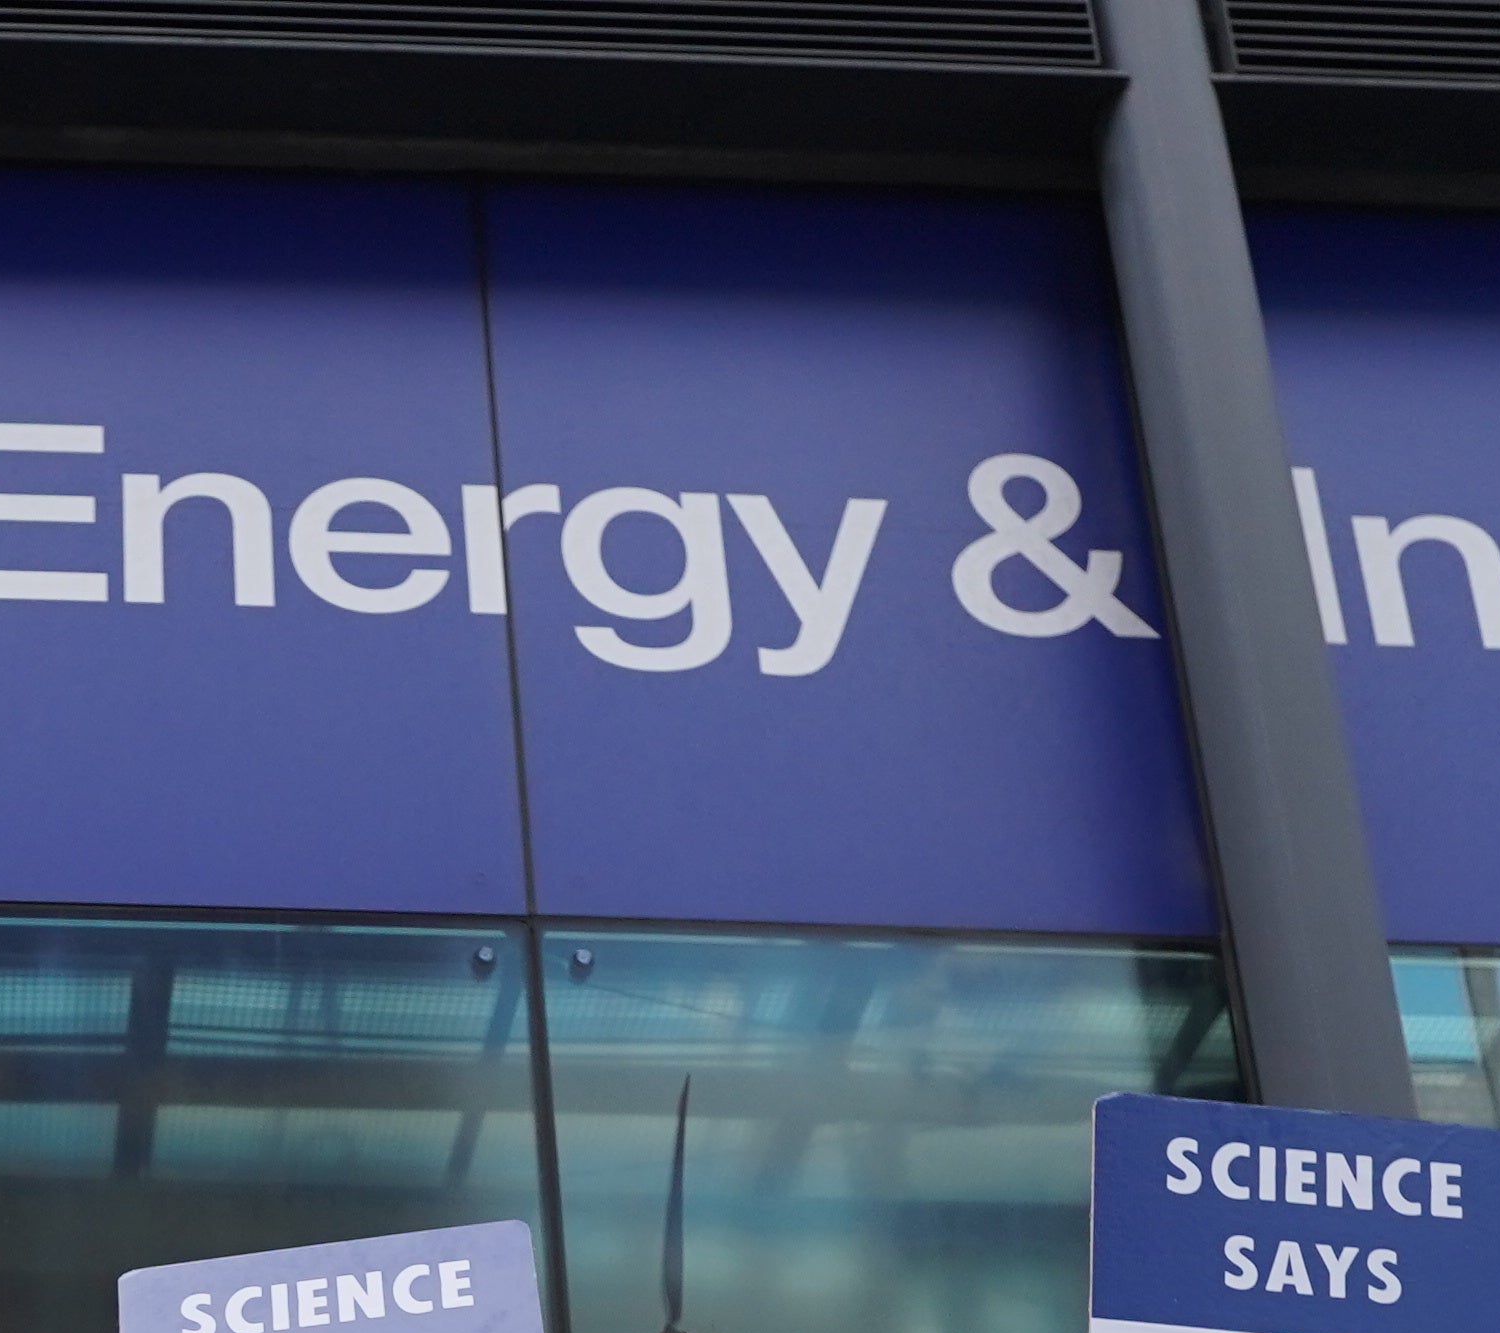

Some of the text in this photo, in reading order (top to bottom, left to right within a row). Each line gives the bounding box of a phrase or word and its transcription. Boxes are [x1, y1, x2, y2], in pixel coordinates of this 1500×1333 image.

[950, 452, 1160, 640] &
[1165, 1135, 1464, 1221] SCIENCE
[1222, 1234, 1403, 1306] SAYS
